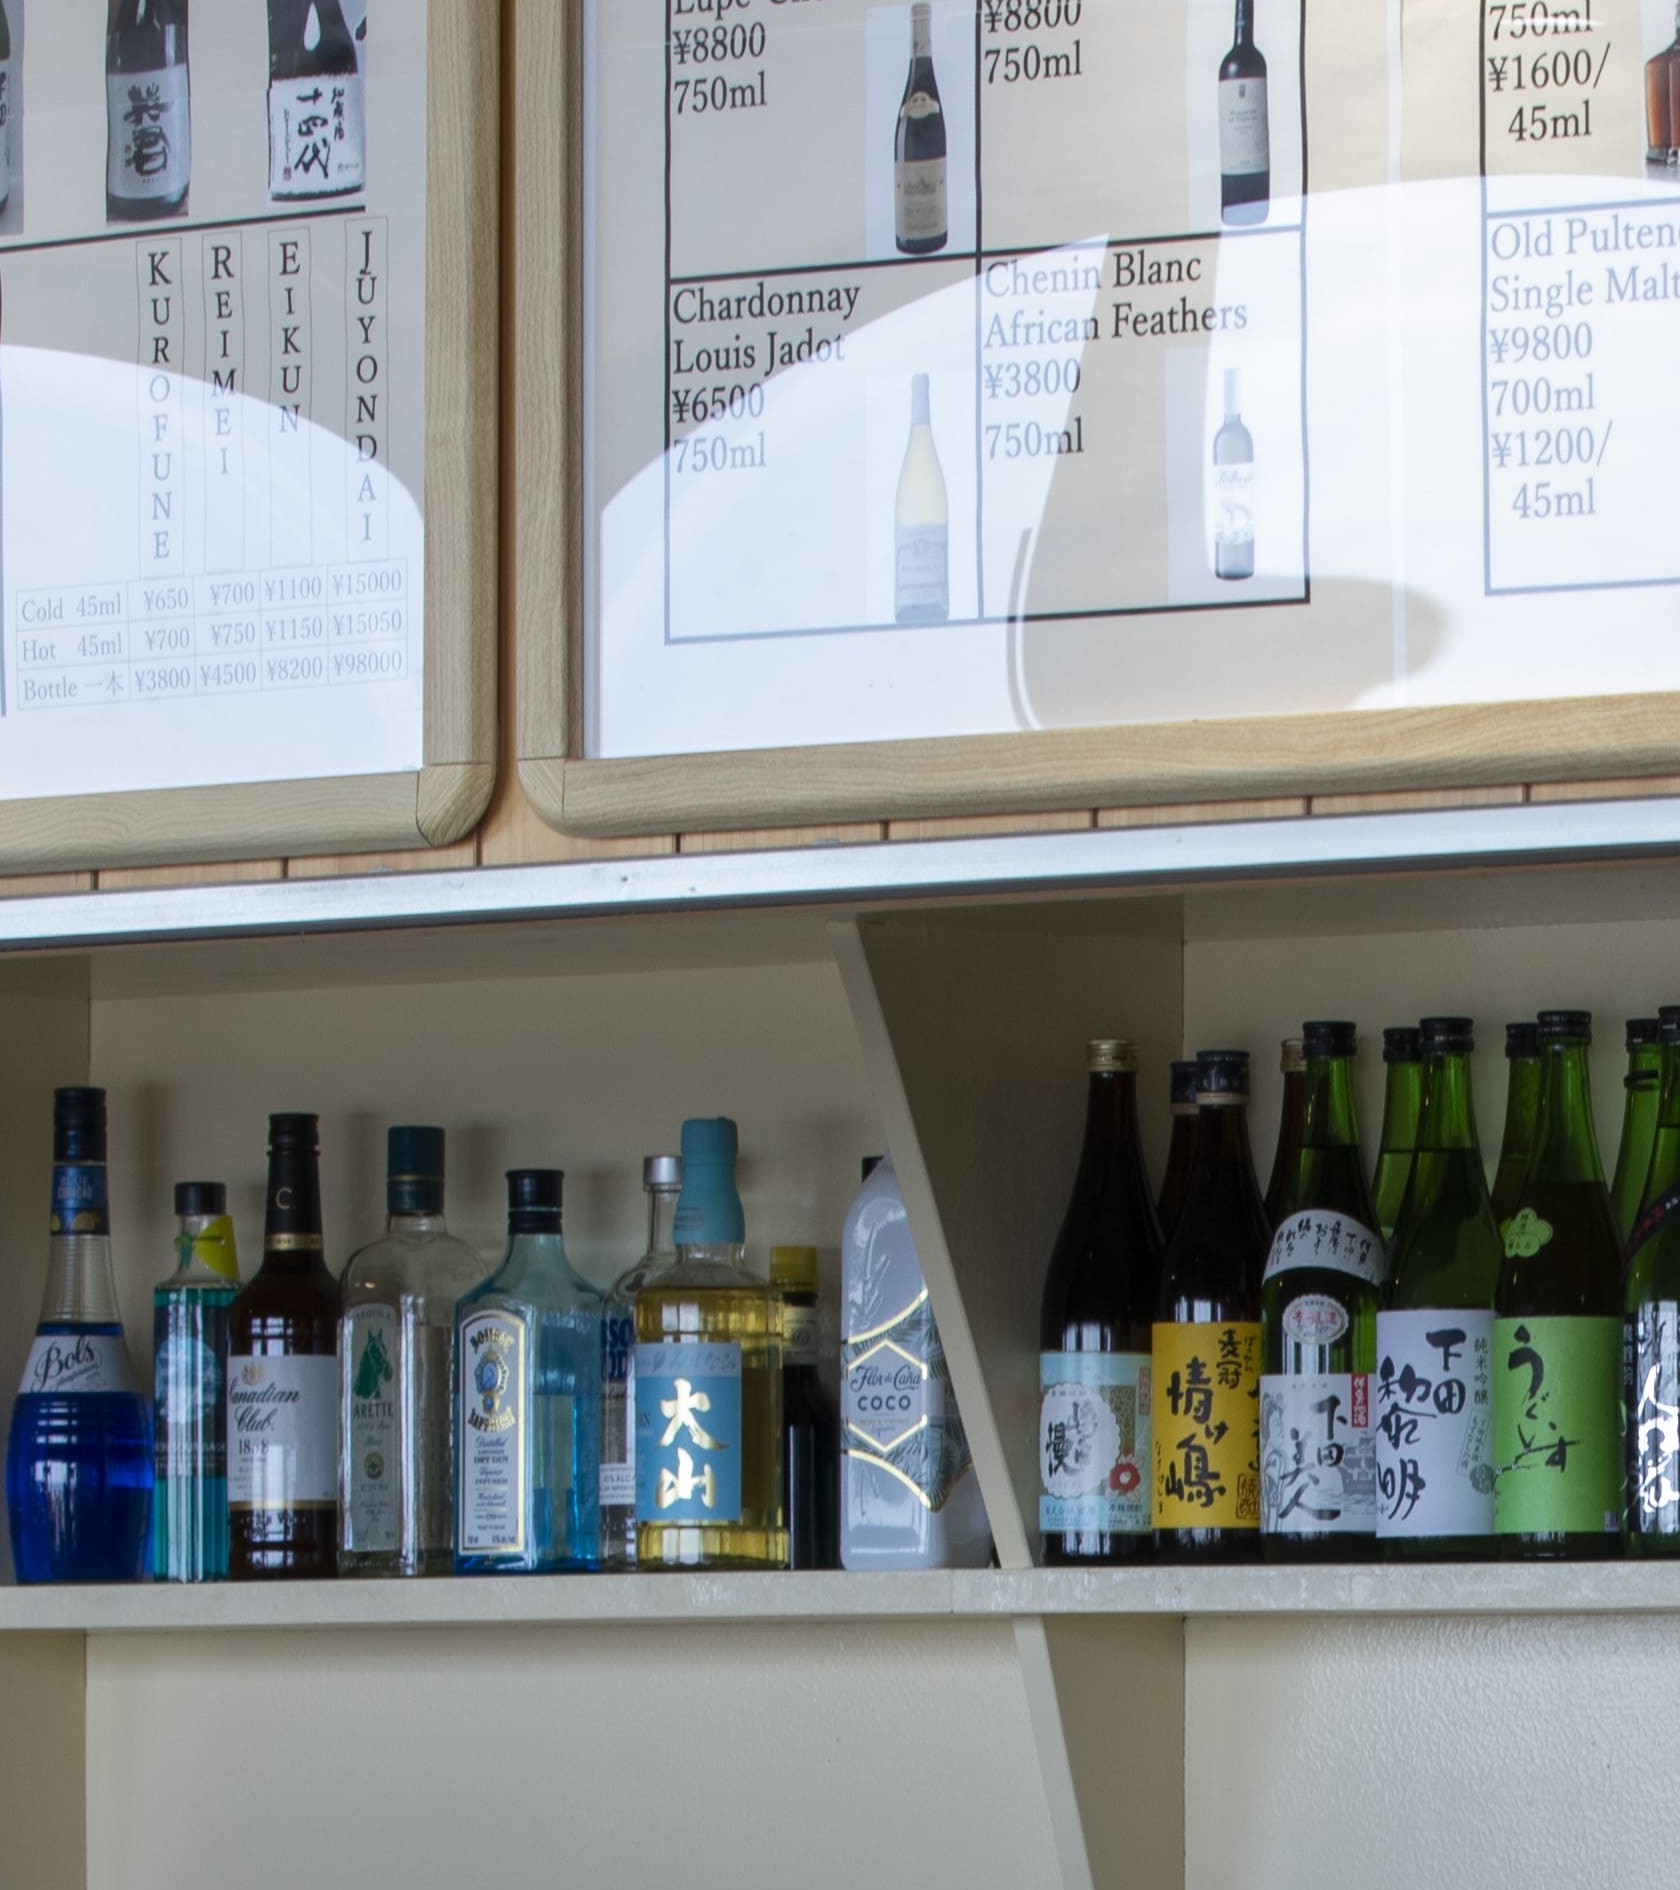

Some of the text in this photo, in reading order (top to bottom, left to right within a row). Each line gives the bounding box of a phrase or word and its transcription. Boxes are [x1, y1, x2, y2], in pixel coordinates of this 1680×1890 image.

[984, 0, 1081, 33] ¥8800
[1489, 0, 1594, 42] 750ml
[673, 22, 765, 64] ¥8800
[985, 40, 1081, 84] 750ml
[1488, 43, 1610, 91] ¥1600/
[674, 70, 766, 114] 750ml
[1509, 99, 1590, 141] 45ml
[1492, 219, 1552, 260] Old
[985, 250, 1200, 297] Chenin Blanc
[1491, 270, 1592, 319] Single
[674, 281, 860, 324] Chardonnay
[984, 298, 1247, 348] African Feathers
[277, 239, 305, 434] EIKUN
[674, 327, 845, 376] Louis Jadot
[1489, 322, 1592, 363] ¥9800
[209, 243, 238, 478] REIMEI
[984, 358, 1081, 398] ¥3800
[148, 251, 172, 557] KUROFUNE
[356, 231, 377, 538] JUYONDAI
[672, 383, 763, 423] ¥6500
[1492, 372, 1594, 416] 700ml
[674, 432, 766, 473] 750ml
[986, 416, 1084, 458] 750ml
[1491, 420, 1613, 468] ¥1200/
[1512, 477, 1595, 518] 45ml
[22, 570, 401, 622] Cold 45ml ¥650 ¥700 ¥1100 ¥15000
[23, 610, 401, 661] Hot 45ml ¥700 ¥750 ¥1150 ¥15050
[24, 651, 401, 701] Bottle 一本 ¥3800 ¥4500 ¥8200 ¥98000
[1425, 1328, 1466, 1414] 下田
[235, 1407, 271, 1432] Club
[353, 1403, 394, 1418] ARETTE
[857, 1396, 911, 1411] COCO
[656, 1378, 728, 1508] 大山
